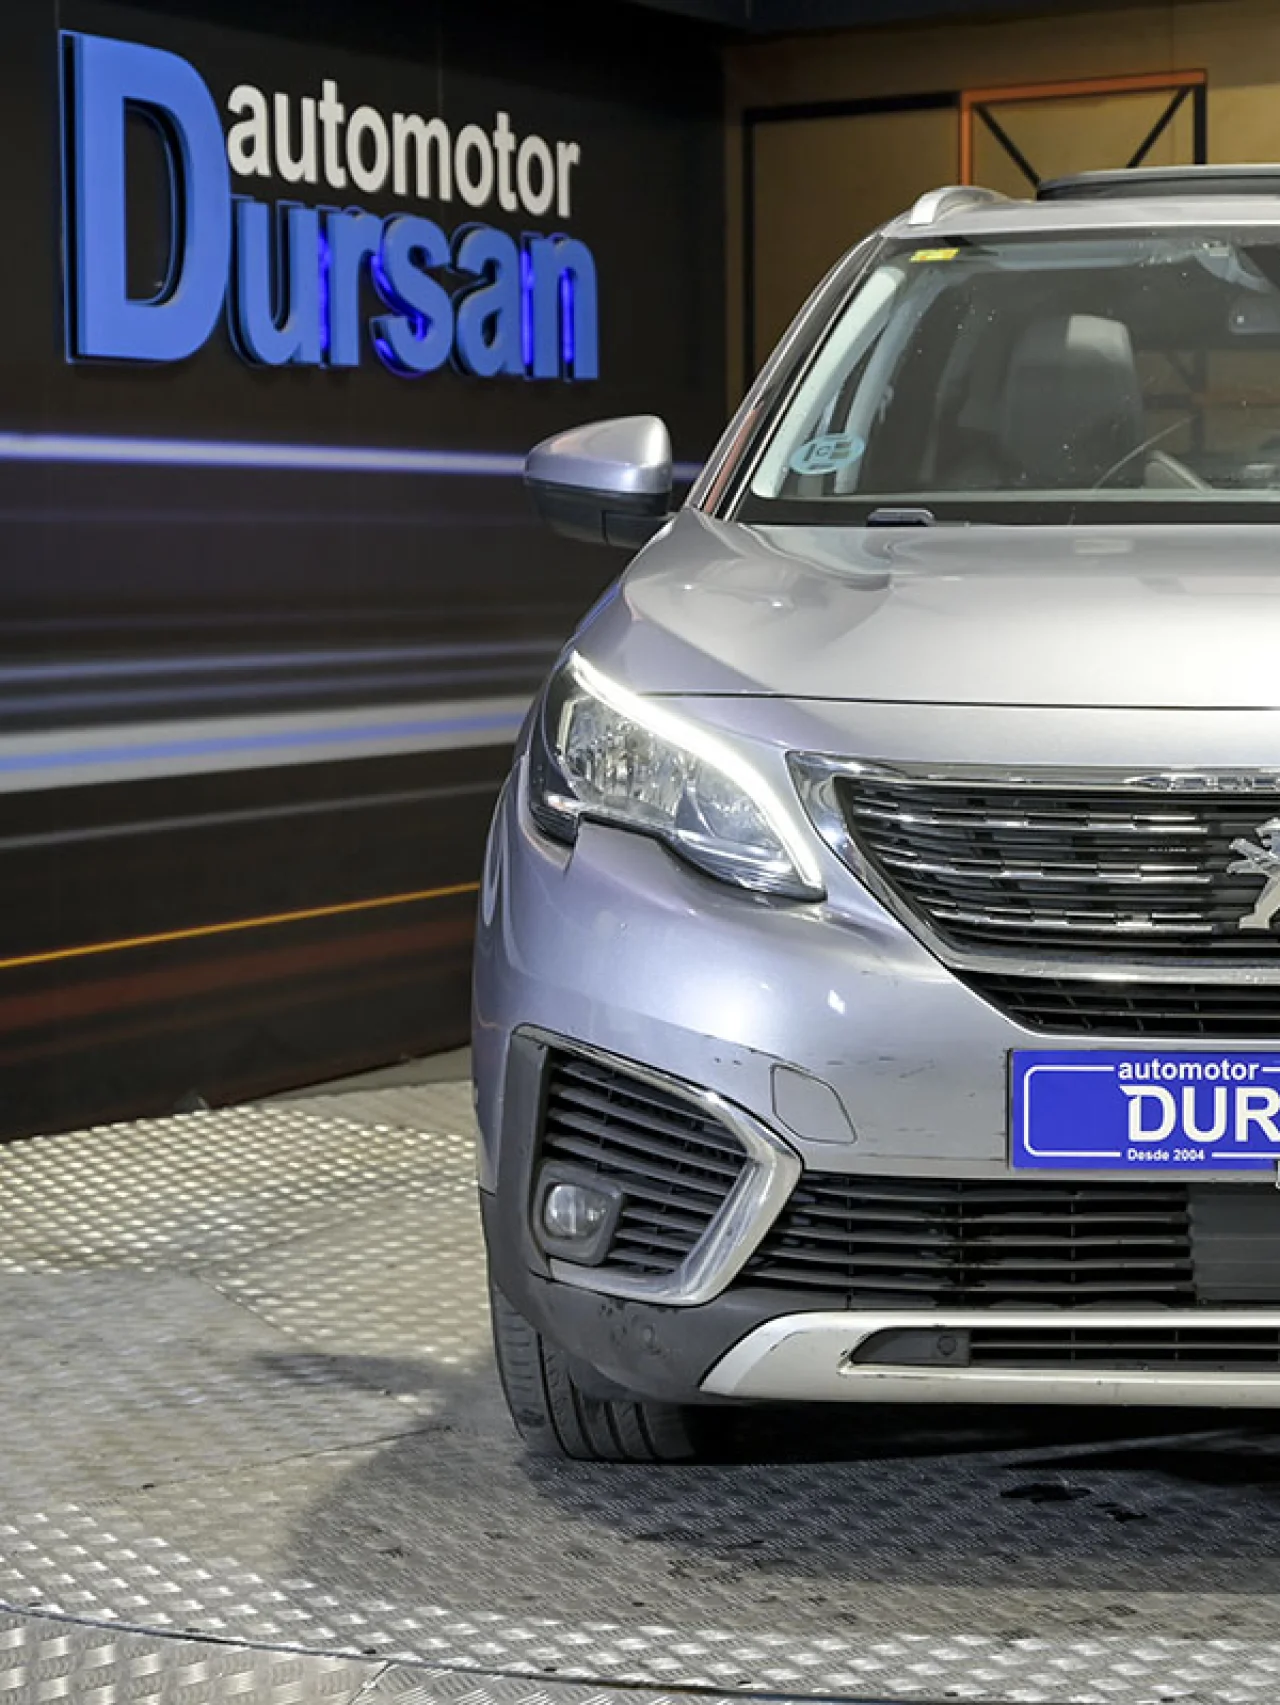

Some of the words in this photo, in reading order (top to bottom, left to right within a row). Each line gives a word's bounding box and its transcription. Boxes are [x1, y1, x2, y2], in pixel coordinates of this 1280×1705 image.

[227, 80, 579, 218] automotor
[60, 29, 598, 381] Dursan
[1118, 1058, 1259, 1080] automotor
[1128, 1148, 1169, 1161] Desde
[1173, 1148, 1205, 1161] 2004
